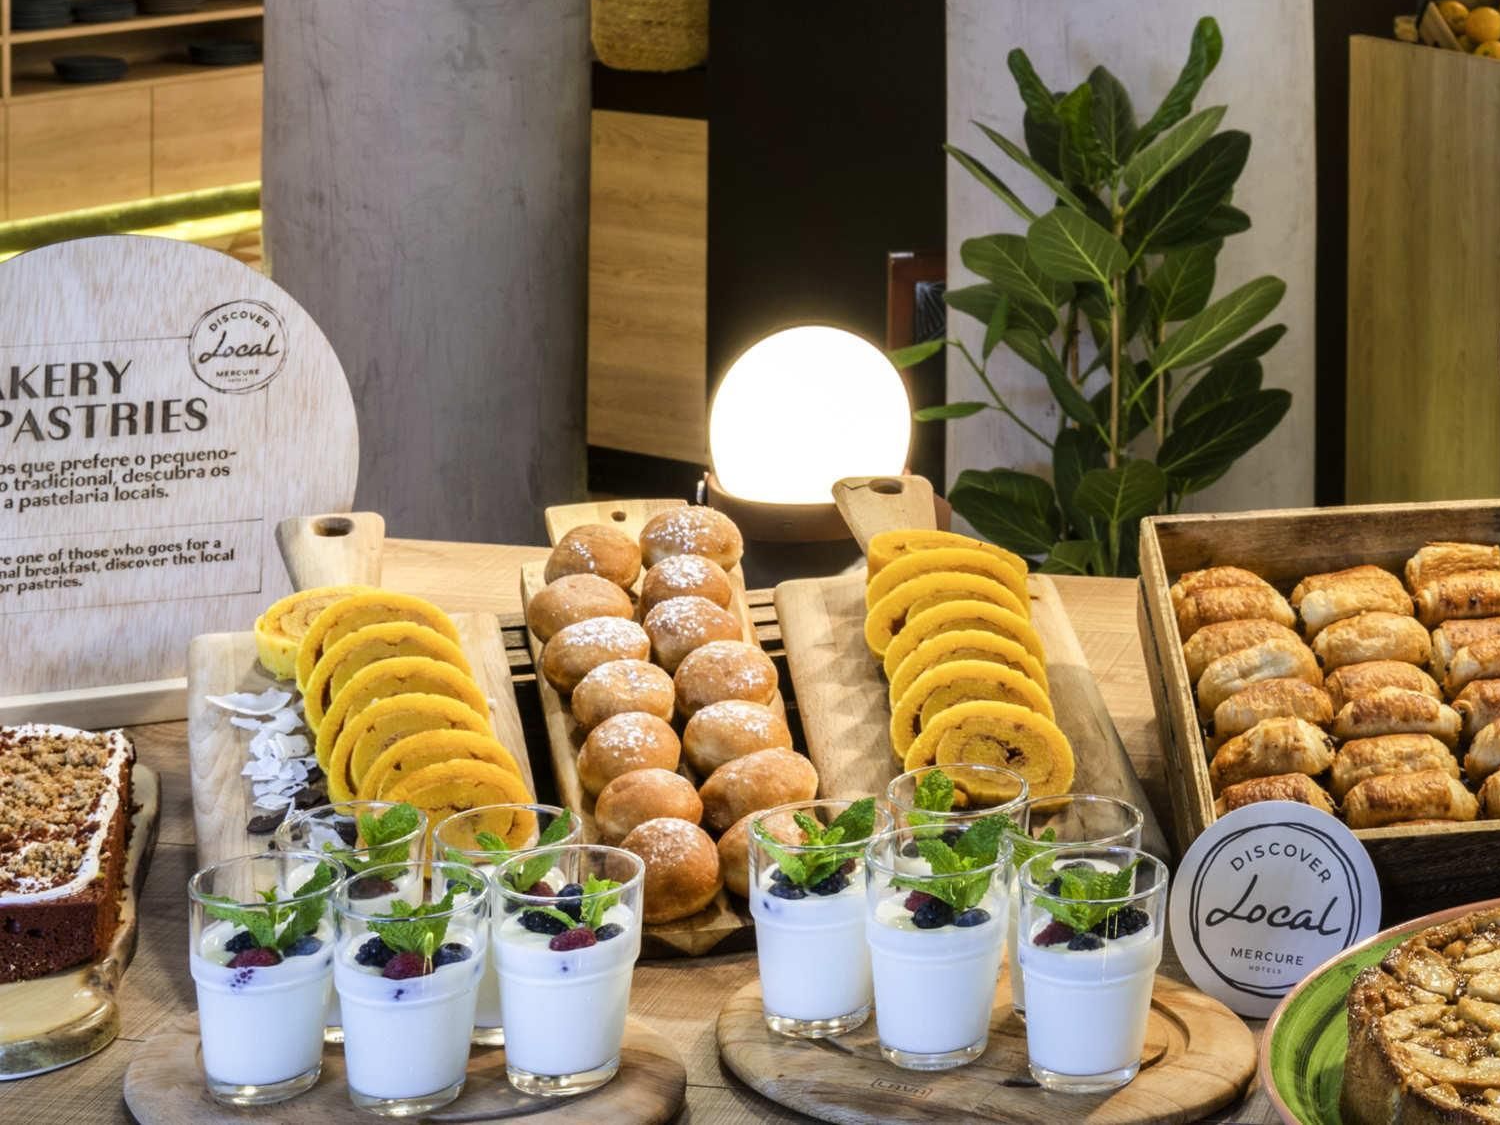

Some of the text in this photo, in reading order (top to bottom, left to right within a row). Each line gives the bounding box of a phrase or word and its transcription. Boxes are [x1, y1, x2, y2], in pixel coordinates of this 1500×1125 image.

[208, 310, 271, 333] DISCOVER
[198, 330, 280, 364] Local
[215, 368, 260, 378] MERCURE
[21, 460, 55, 478] que
[60, 453, 130, 476] prefere
[134, 454, 146, 466] o
[150, 449, 237, 470] pequeno-
[14, 469, 117, 491] tradicional,
[122, 465, 206, 483] descubra
[210, 466, 231, 477] os
[4, 483, 169, 513] a pastelaria locais.
[0, 538, 222, 565] e one of those who goes for a
[24, 561, 102, 577] breakfast,
[105, 557, 168, 572] discover
[172, 551, 196, 565] the
[200, 548, 235, 563] local
[17, 576, 83, 596] pastries.
[1230, 842, 1332, 884] DISCOVER
[1205, 874, 1342, 936] Local
[1230, 947, 1305, 966] MERCURE
[1248, 965, 1282, 975] HOTELS
